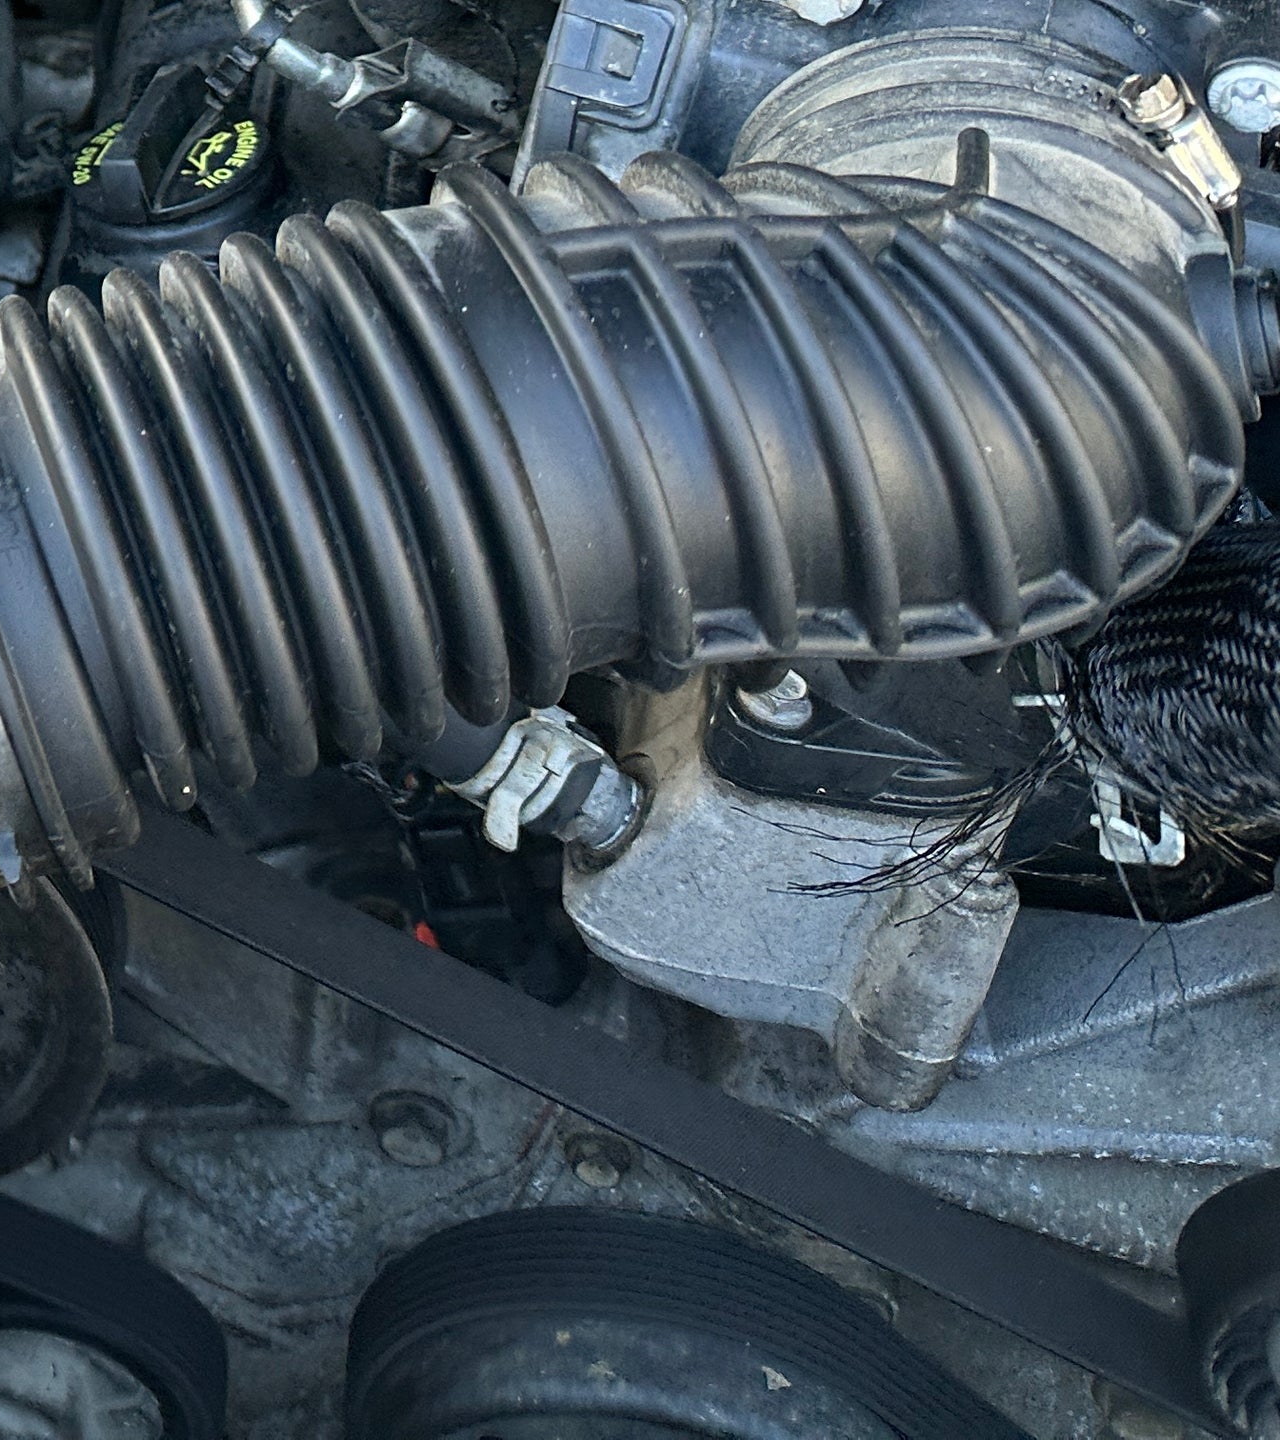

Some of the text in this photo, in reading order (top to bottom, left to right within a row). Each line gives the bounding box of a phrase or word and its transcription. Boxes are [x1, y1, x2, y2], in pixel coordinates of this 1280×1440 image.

[72, 122, 124, 185] SAE 5W-20
[194, 120, 259, 190] ENGINE OIL
